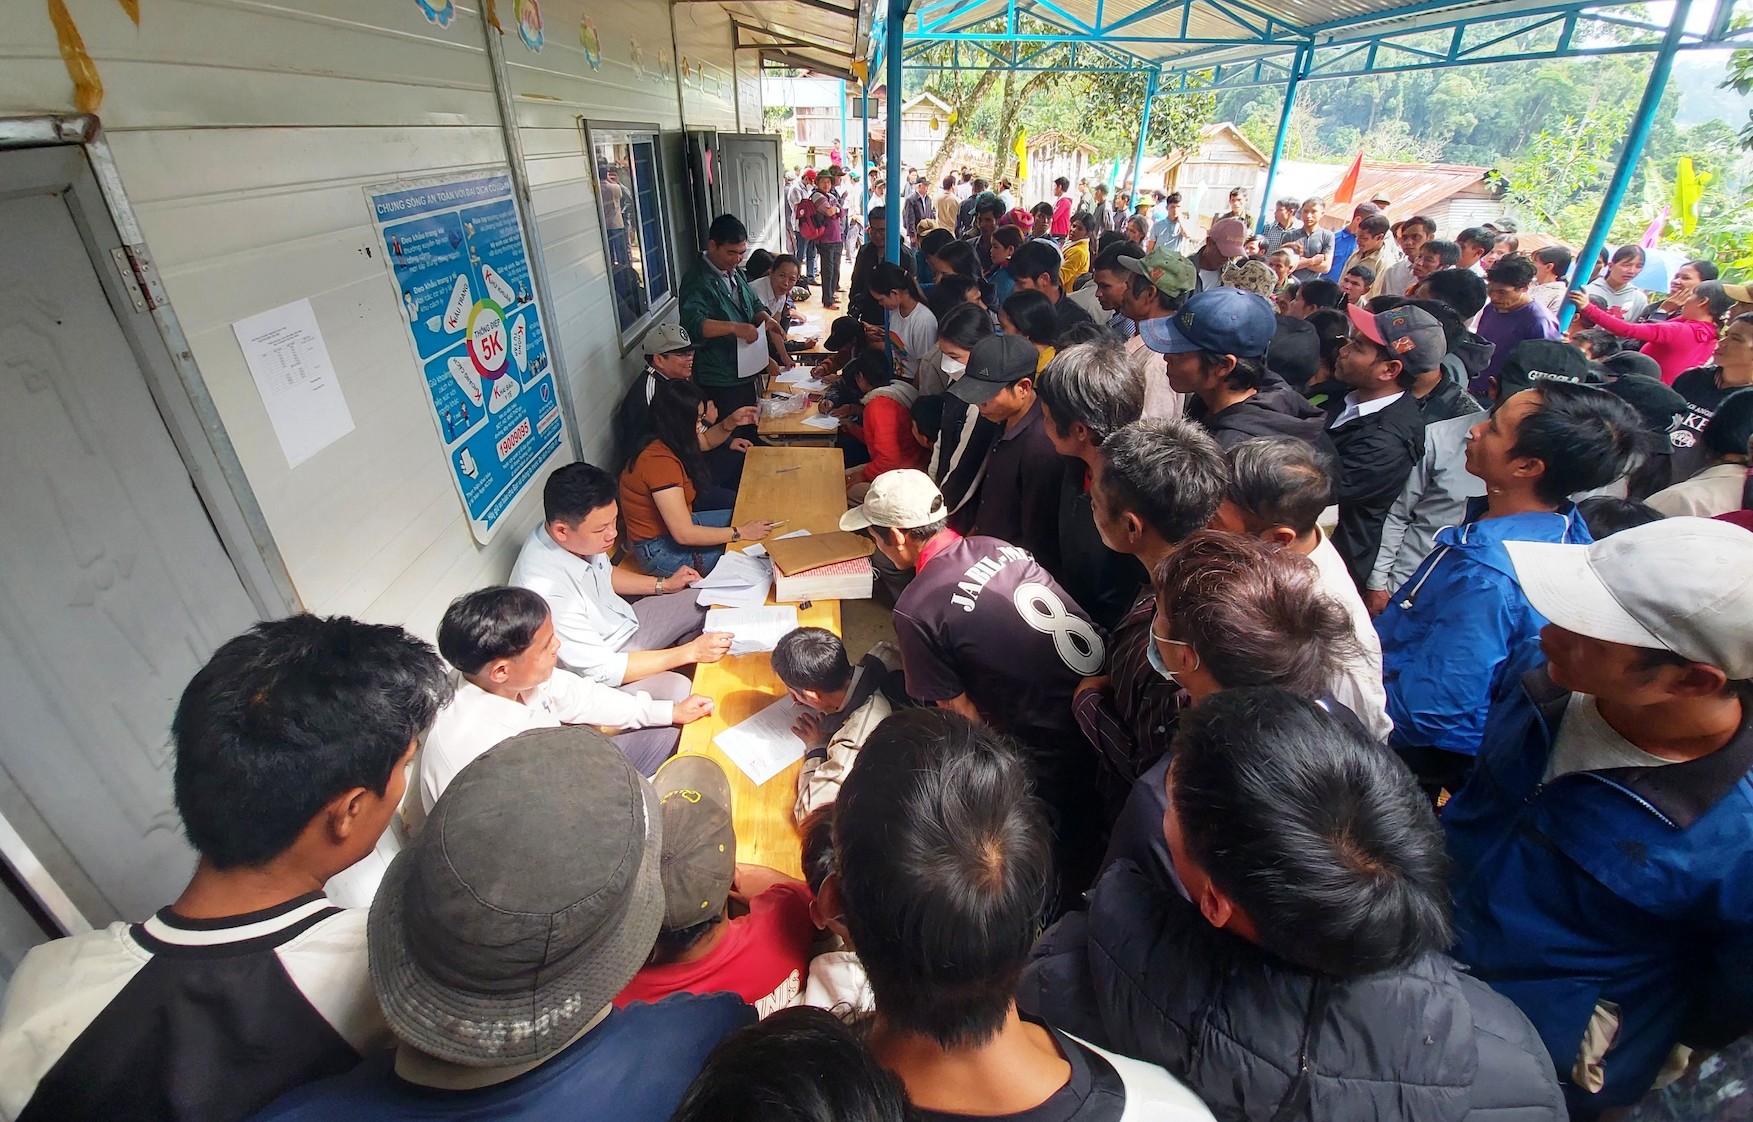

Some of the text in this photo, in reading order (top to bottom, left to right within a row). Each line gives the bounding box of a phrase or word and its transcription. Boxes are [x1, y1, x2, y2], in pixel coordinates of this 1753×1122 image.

[377, 200, 405, 214] CHUNG
[427, 194, 437, 205] AN
[481, 330, 504, 361] 5K
[1682, 412, 1710, 432] KE
[1694, 407, 1715, 418] ANGE
[499, 421, 529, 456] 19009095
[1014, 582, 1105, 677] 8
